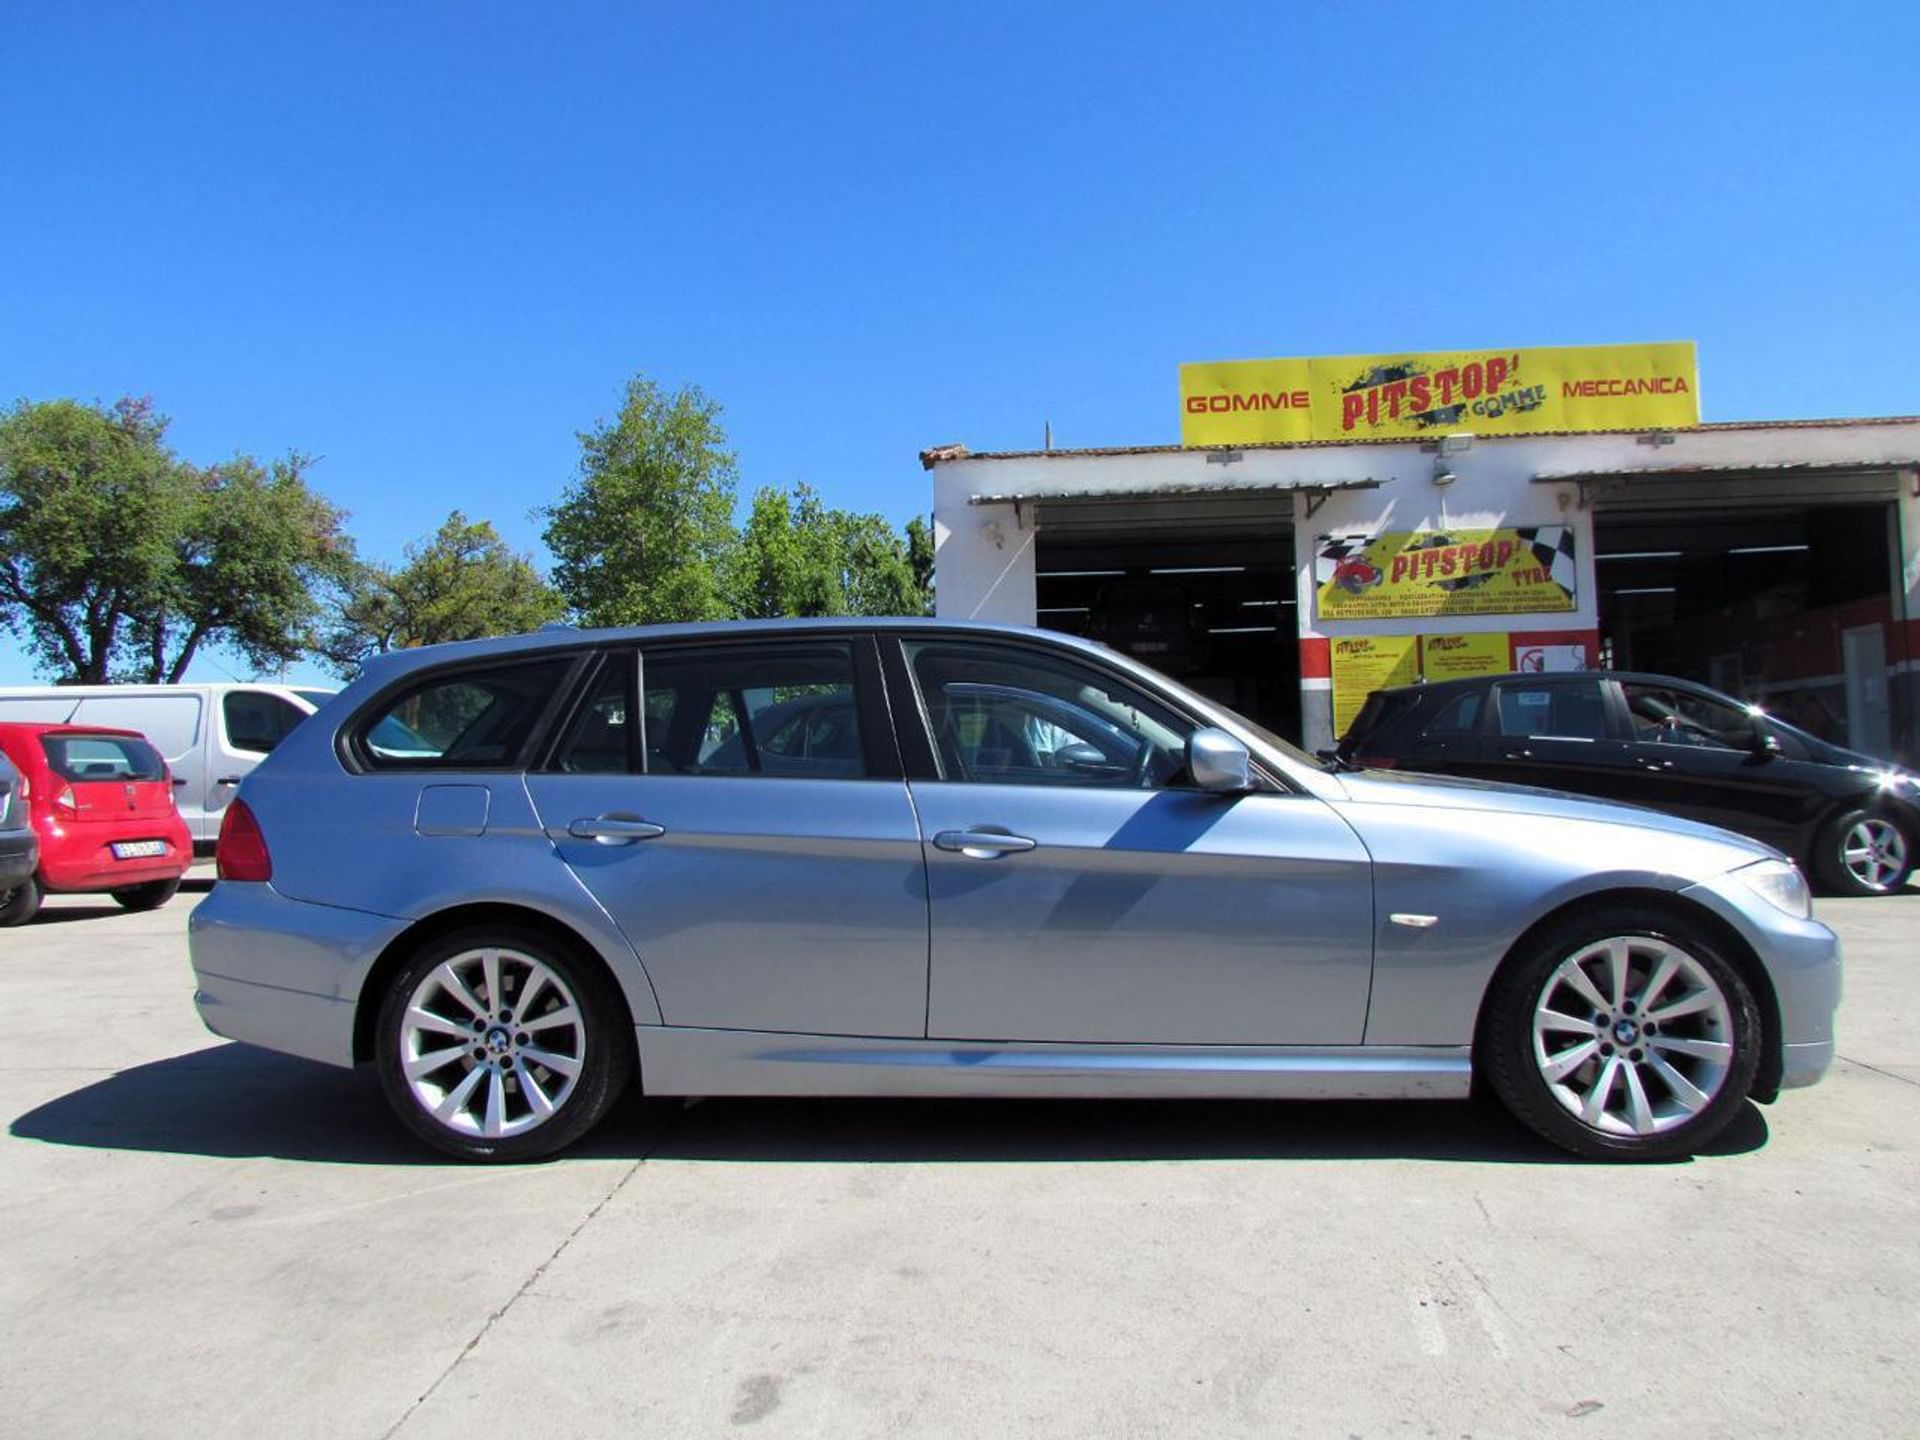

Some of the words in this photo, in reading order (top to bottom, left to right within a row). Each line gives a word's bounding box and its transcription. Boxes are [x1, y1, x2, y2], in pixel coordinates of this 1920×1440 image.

[1562, 375, 1689, 398] MECCANICA
[1186, 390, 1310, 414] GOMME
[1471, 384, 1545, 418] GOMME
